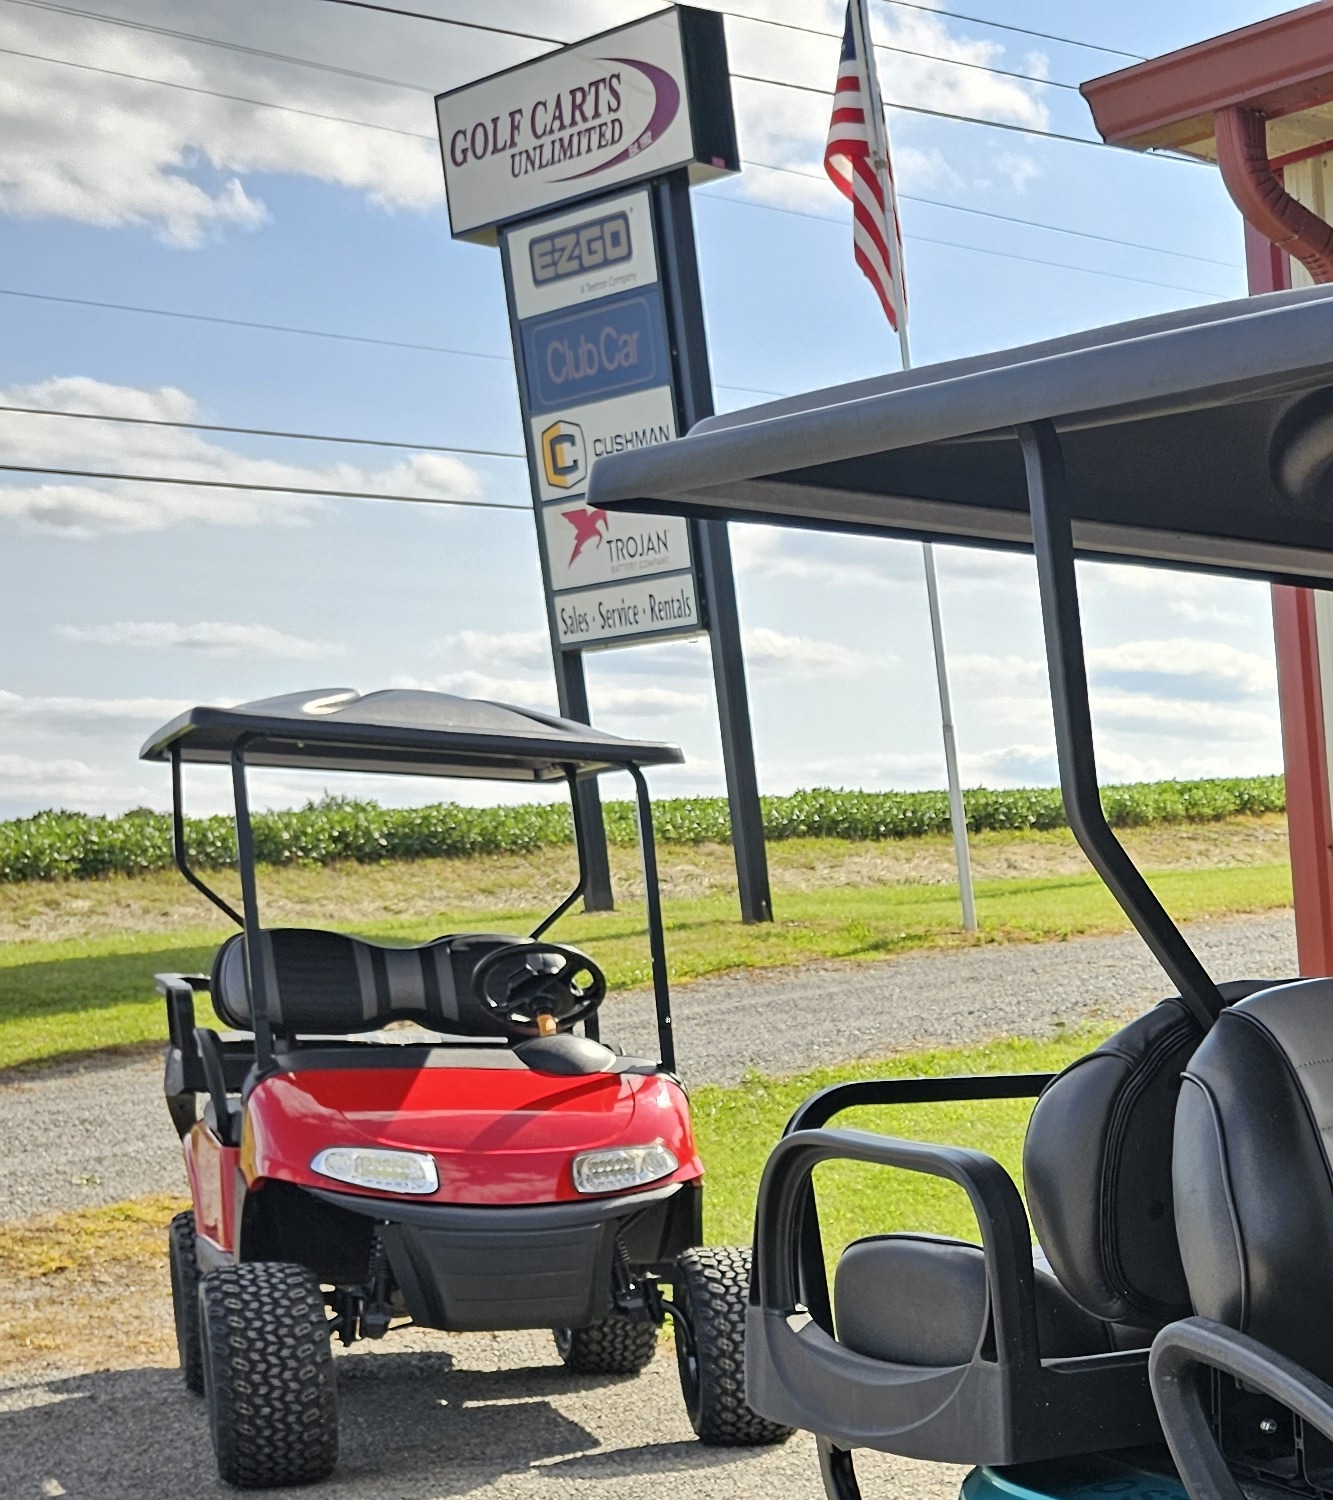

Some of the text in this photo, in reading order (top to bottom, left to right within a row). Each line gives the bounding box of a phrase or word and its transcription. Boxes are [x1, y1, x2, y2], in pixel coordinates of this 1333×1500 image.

[450, 71, 622, 168] GOLF CARTS
[510, 117, 624, 178] UNLIMITED
[532, 218, 630, 283] EZGO
[546, 325, 642, 385] Club Car
[593, 424, 670, 457] CUSHMAN
[606, 530, 670, 563] TROJAN
[560, 588, 692, 635] Sales Service Rentals
